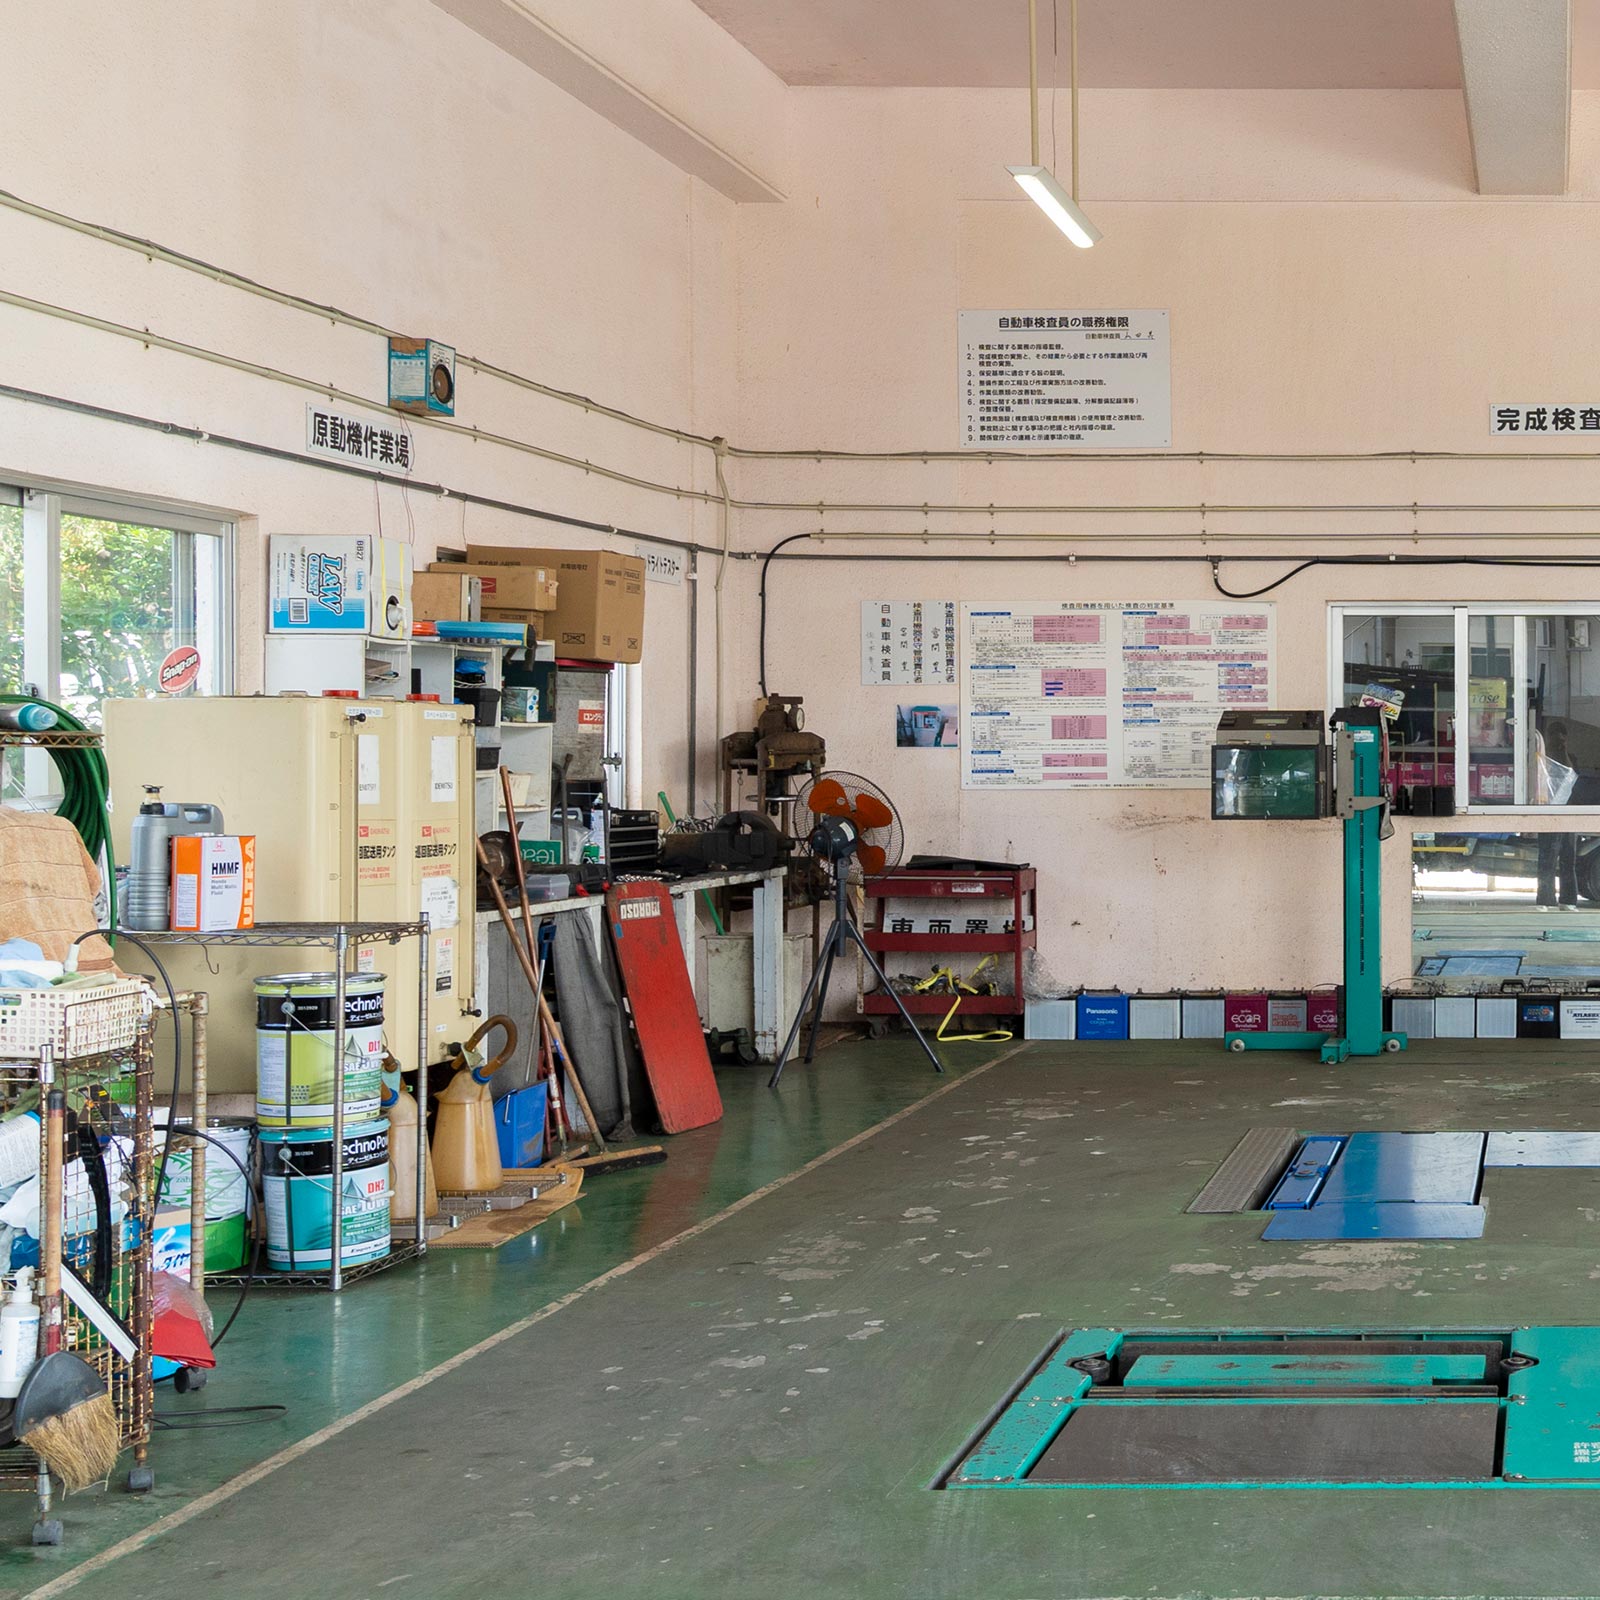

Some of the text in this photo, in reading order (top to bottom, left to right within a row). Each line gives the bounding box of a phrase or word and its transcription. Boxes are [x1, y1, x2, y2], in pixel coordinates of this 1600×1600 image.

[999, 316, 1129, 329] 自動車検査員の職務権限
[312, 412, 409, 468] 原動機作業場
[881, 604, 892, 681] 自動車検査員
[162, 653, 198, 683] Snap-on
[211, 862, 240, 875] HMMF
[243, 838, 255, 925] ULTRA
[367, 1179, 385, 1194] DH2
